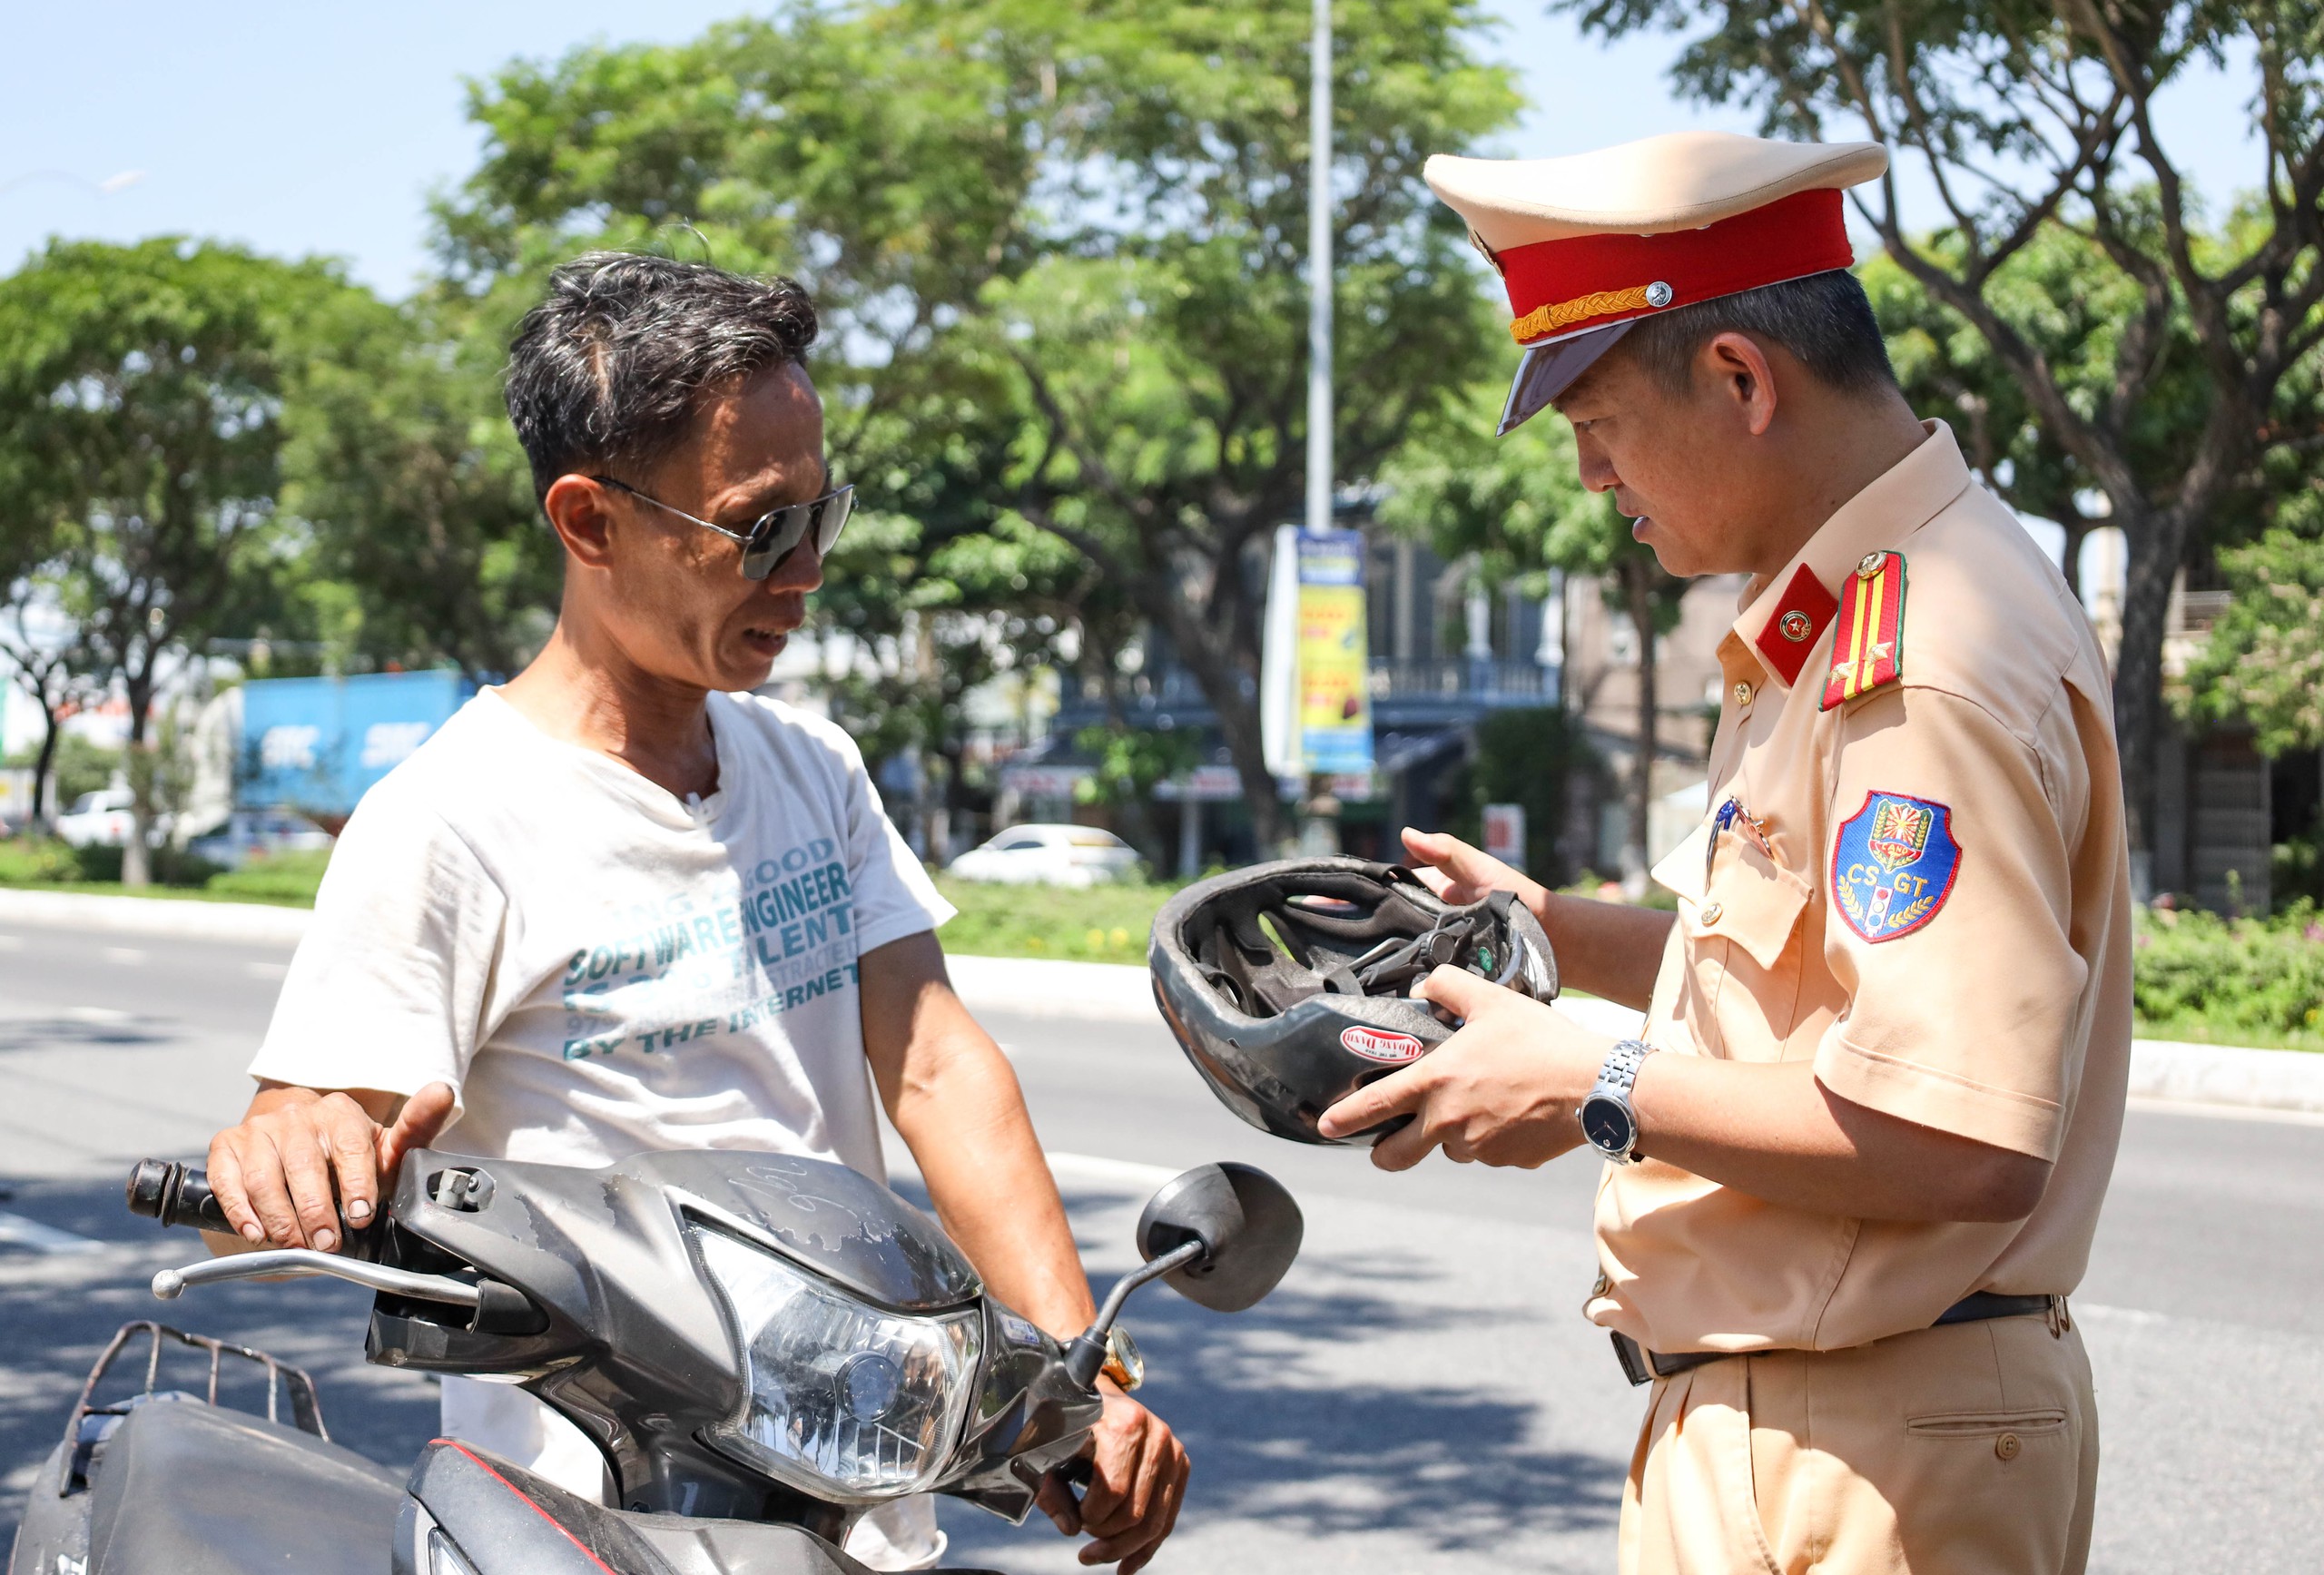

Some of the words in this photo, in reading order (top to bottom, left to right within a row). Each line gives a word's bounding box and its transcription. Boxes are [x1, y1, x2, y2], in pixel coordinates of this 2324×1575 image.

[743, 837, 835, 892] GOOD
[1847, 863, 1880, 886] CS
[1894, 872, 1929, 897] GT
[564, 907, 740, 987] SOFTWARE
[740, 861, 852, 938] NGINEER
[563, 1039, 626, 1060] BY
[635, 1018, 718, 1054] THE
[728, 962, 859, 1034] INTERNET
